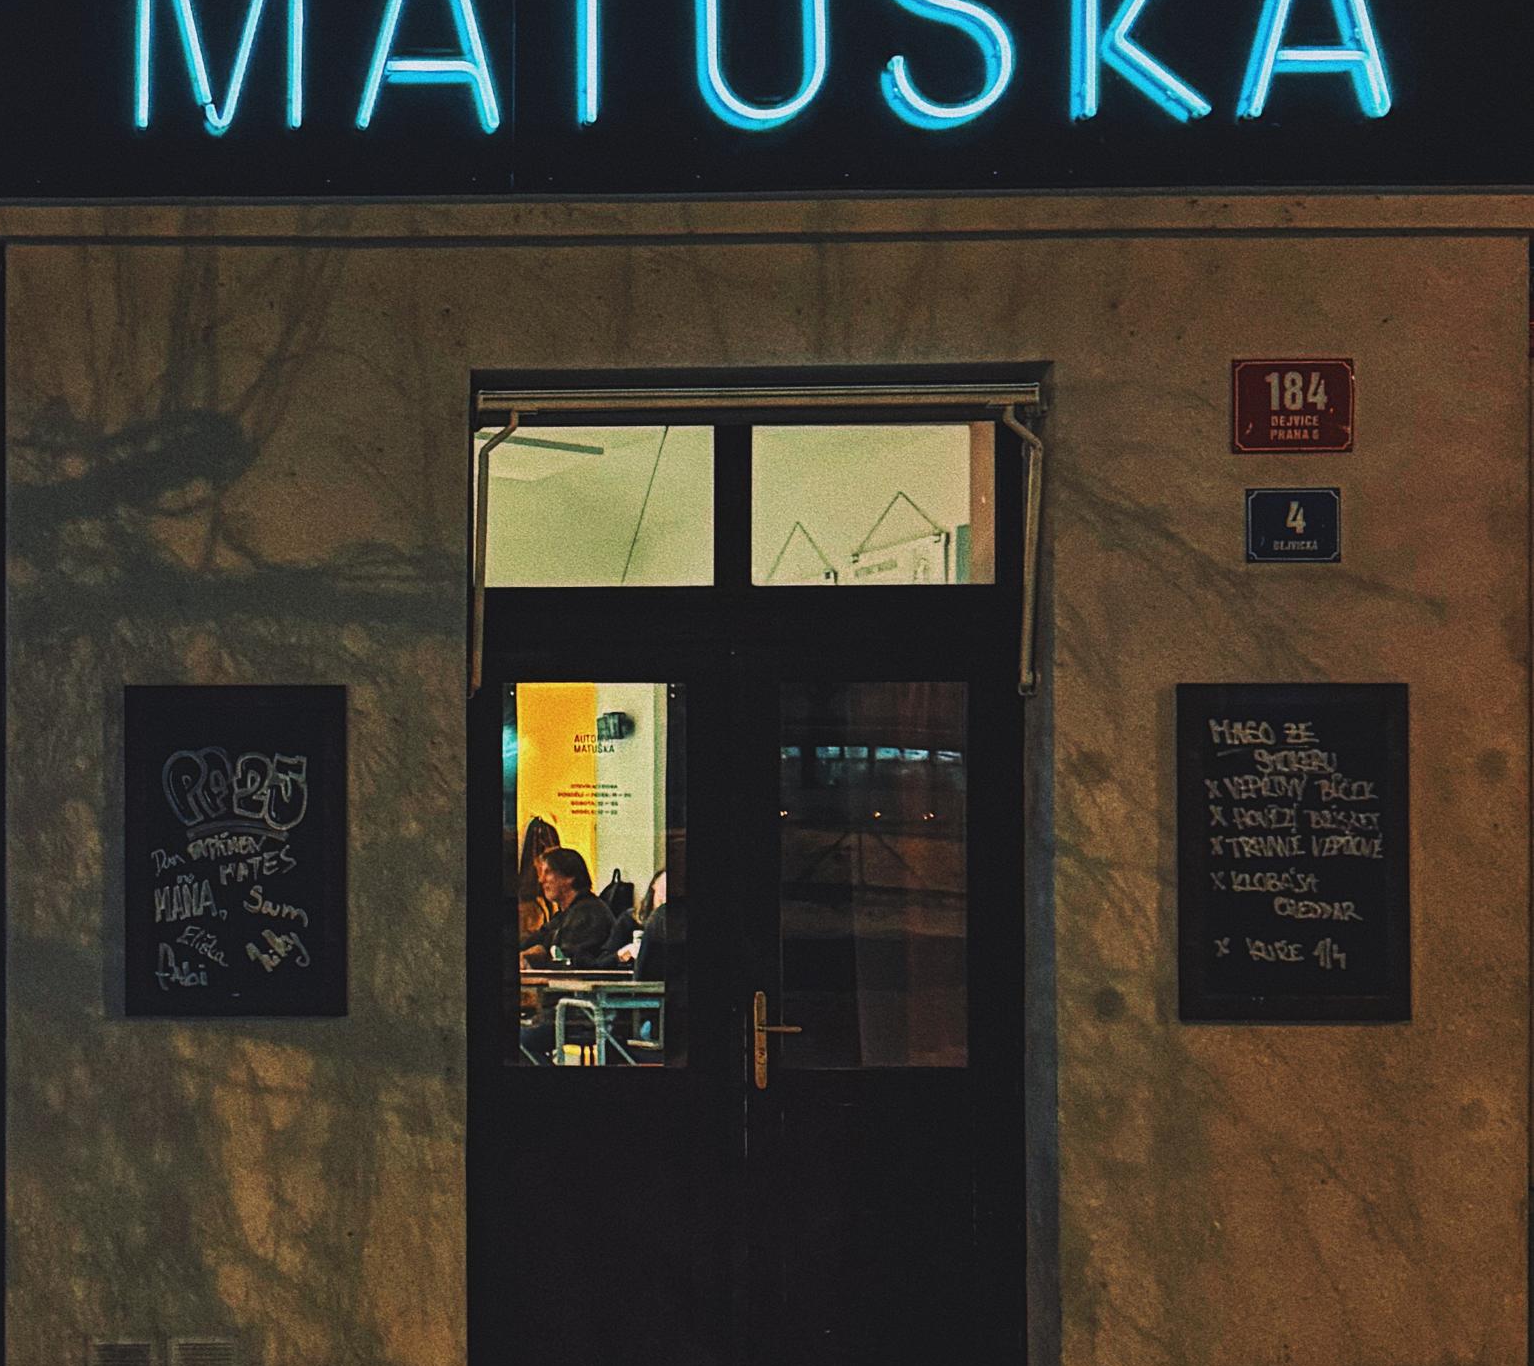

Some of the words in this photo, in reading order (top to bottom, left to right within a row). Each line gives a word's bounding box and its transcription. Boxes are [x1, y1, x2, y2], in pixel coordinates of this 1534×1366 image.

[1265, 371, 1328, 411] 184
[1269, 428, 1309, 441] PRAHA
[1270, 415, 1319, 427] DEJVICE
[1285, 500, 1307, 534] 4
[1208, 718, 1275, 746] MASO
[1273, 896, 1364, 922] CHEDDAR
